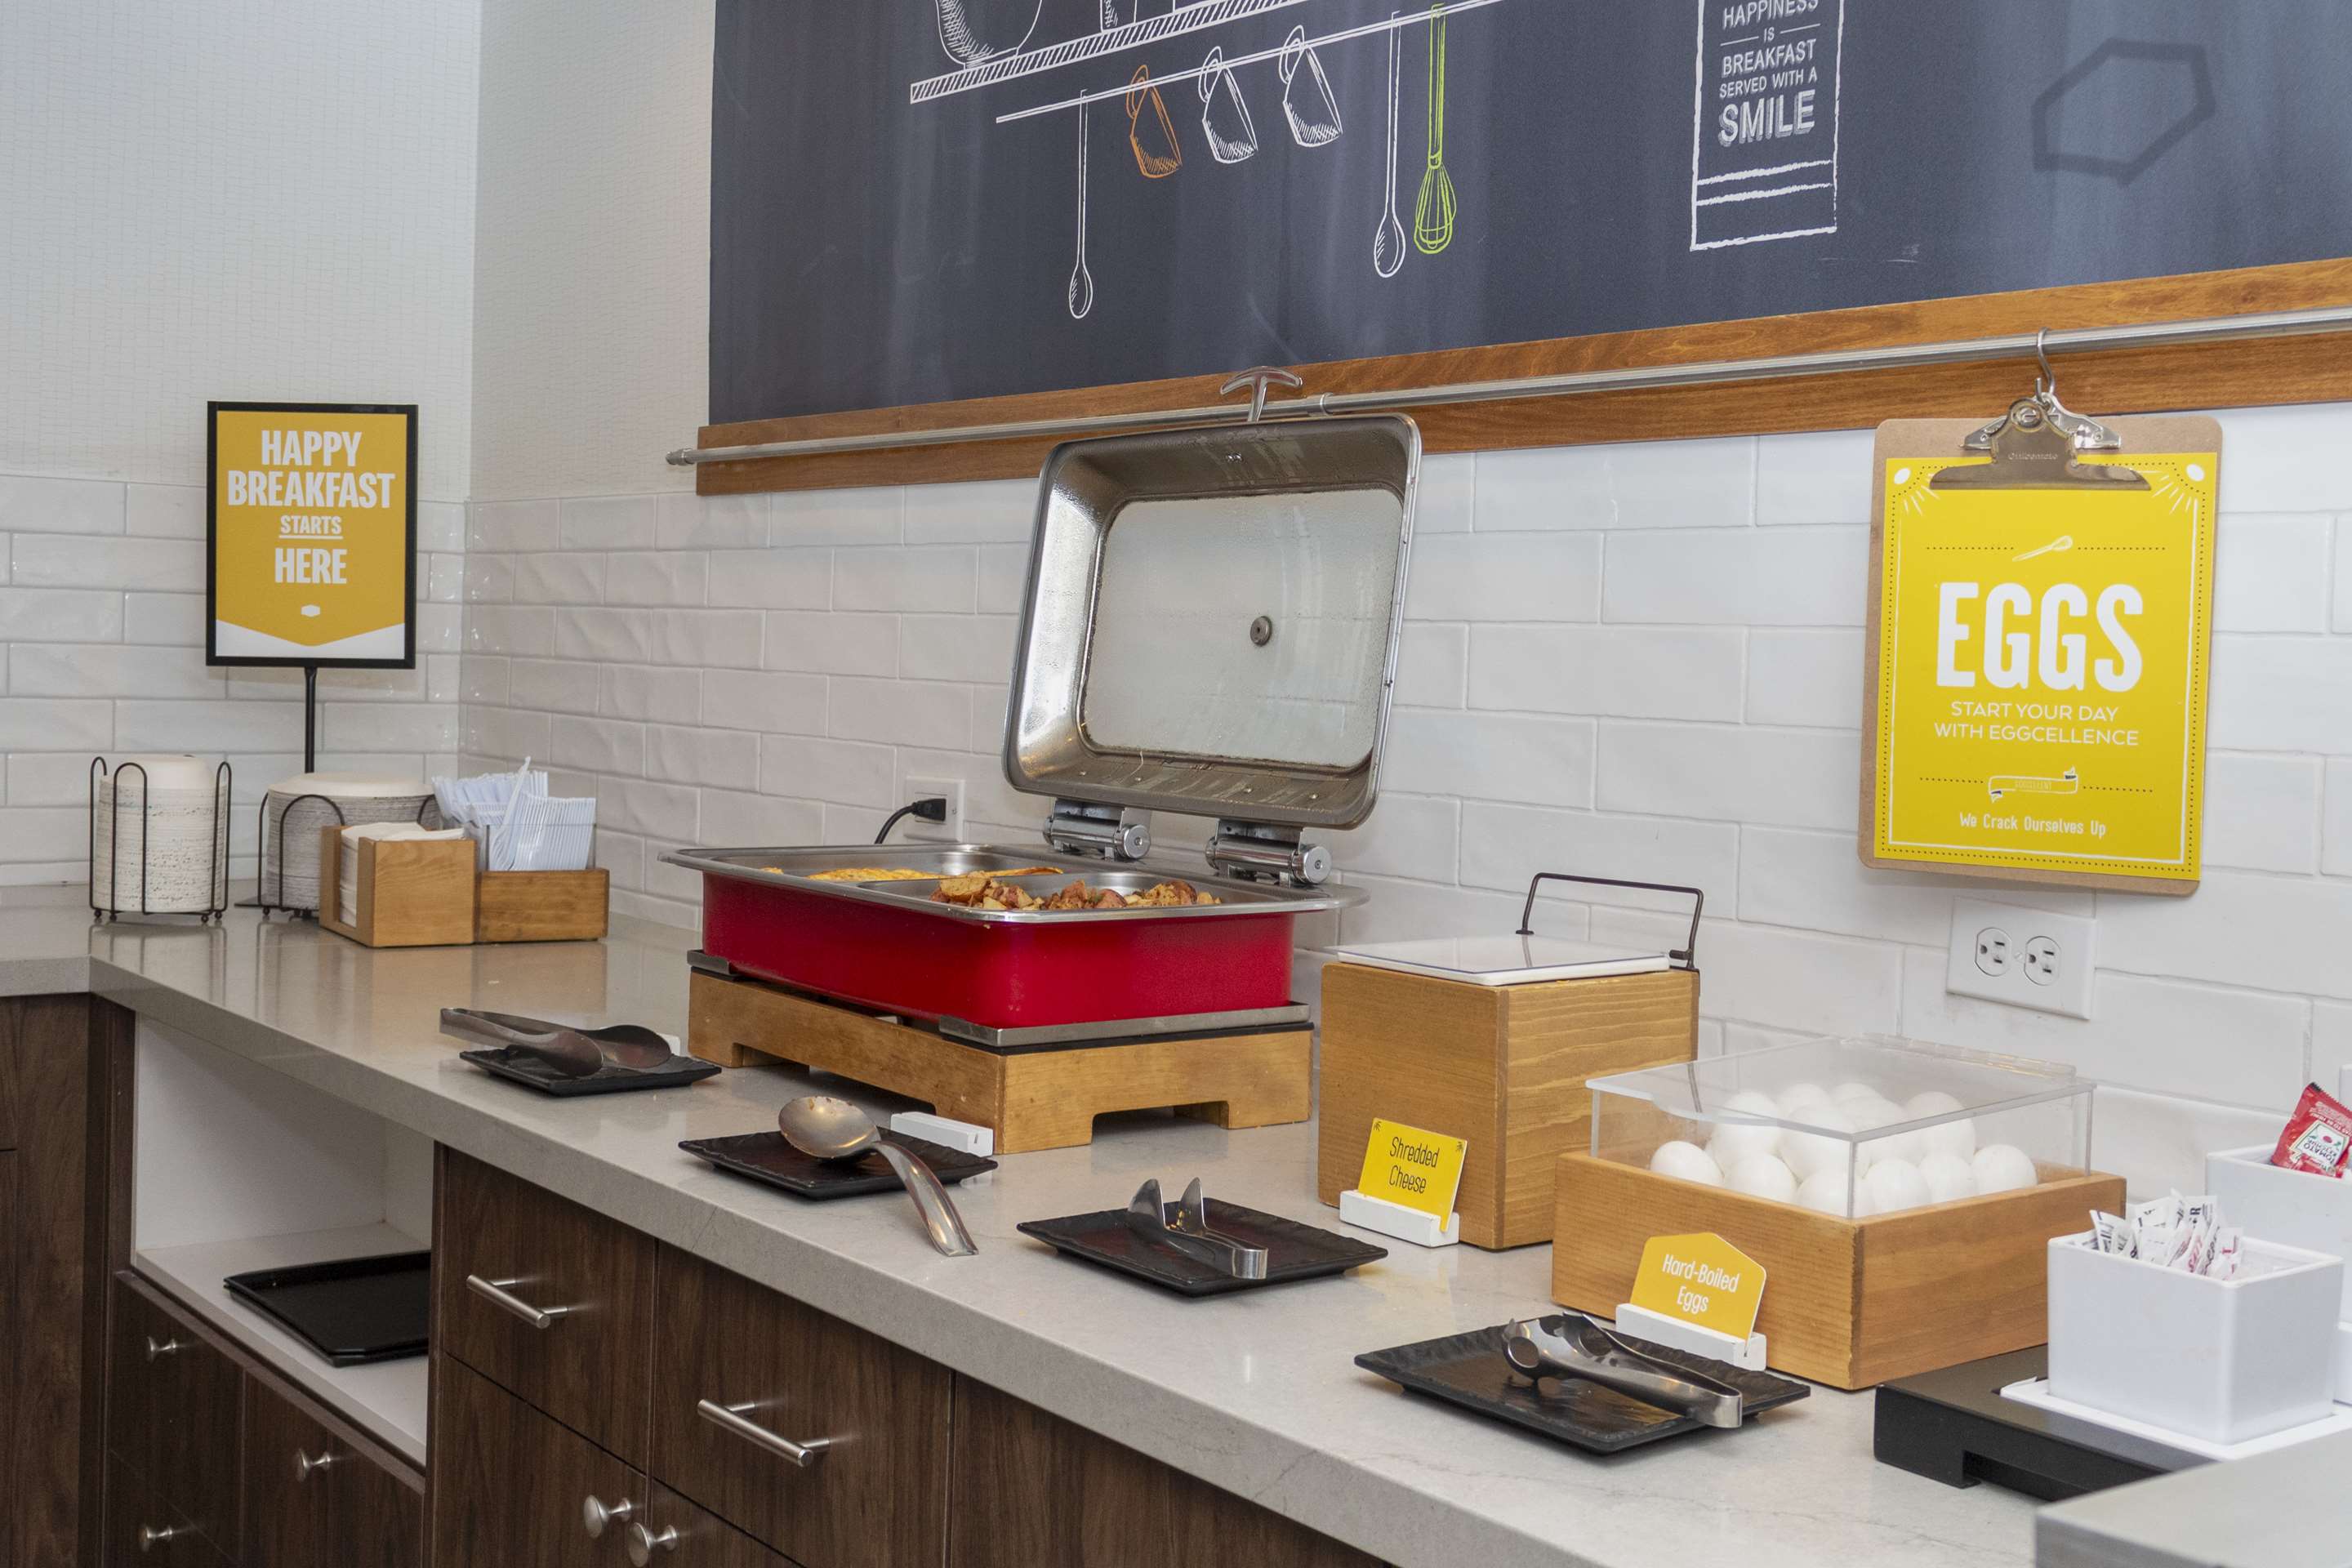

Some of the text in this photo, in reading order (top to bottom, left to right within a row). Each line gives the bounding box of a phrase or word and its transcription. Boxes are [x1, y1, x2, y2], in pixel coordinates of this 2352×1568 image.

[1764, 26, 1775, 42] IS
[1721, 38, 1816, 78] BREAKFAST
[1719, 66, 1818, 99] SERVED WITH A
[1718, 89, 1815, 147] SMILE
[261, 430, 362, 466] HAPPY
[228, 470, 395, 508] BREAKFAST
[280, 515, 341, 535] STARTS
[274, 548, 347, 584] HERE
[1936, 581, 2144, 693] EGGS
[1950, 702, 2119, 724] START YOUR DAY
[1935, 722, 2139, 746] WITH EGGCELLENCE
[1959, 813, 2106, 838] We Crack Ourselves Up
[1389, 1136, 1440, 1168] Shredded
[1388, 1165, 1427, 1194] Cheese
[1662, 1254, 1740, 1294] Hard-Boiled
[1677, 1285, 1709, 1315] Eggs
